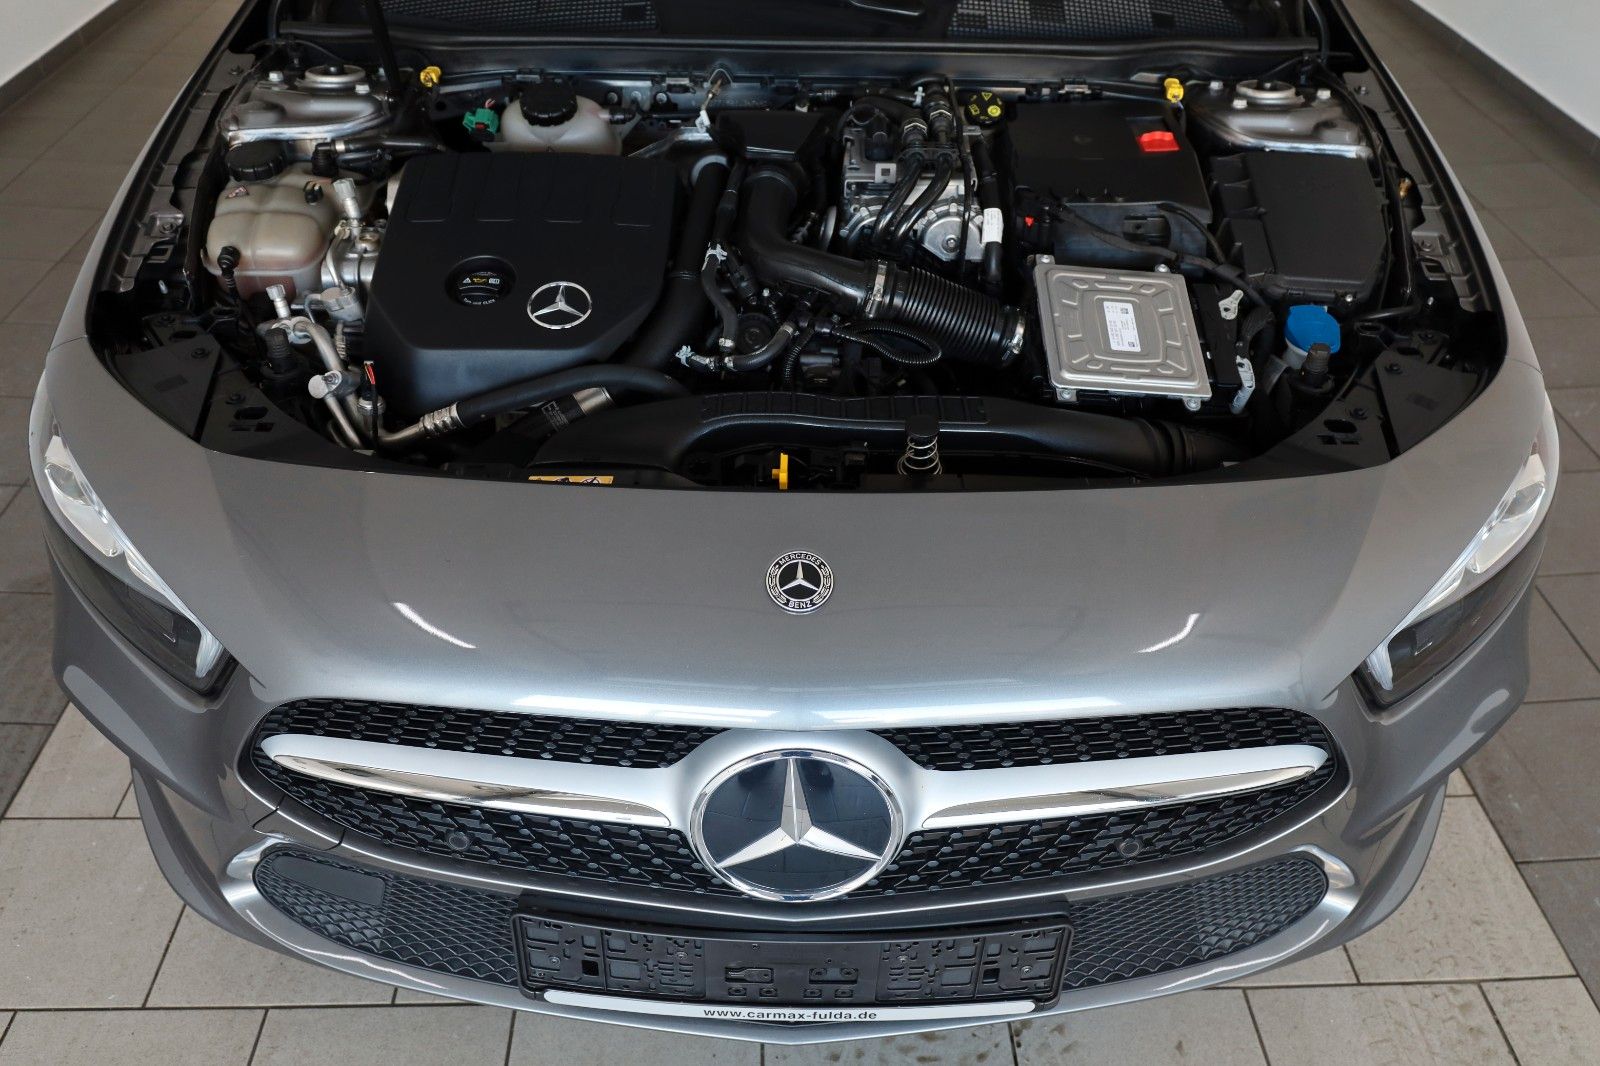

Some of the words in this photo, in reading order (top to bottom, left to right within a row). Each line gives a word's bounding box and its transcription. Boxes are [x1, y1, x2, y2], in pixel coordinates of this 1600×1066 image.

[778, 553, 821, 565] MERCEDES
[788, 600, 812, 609] BENZ
[703, 1009, 877, 1020] www.carmax-fulda.de
